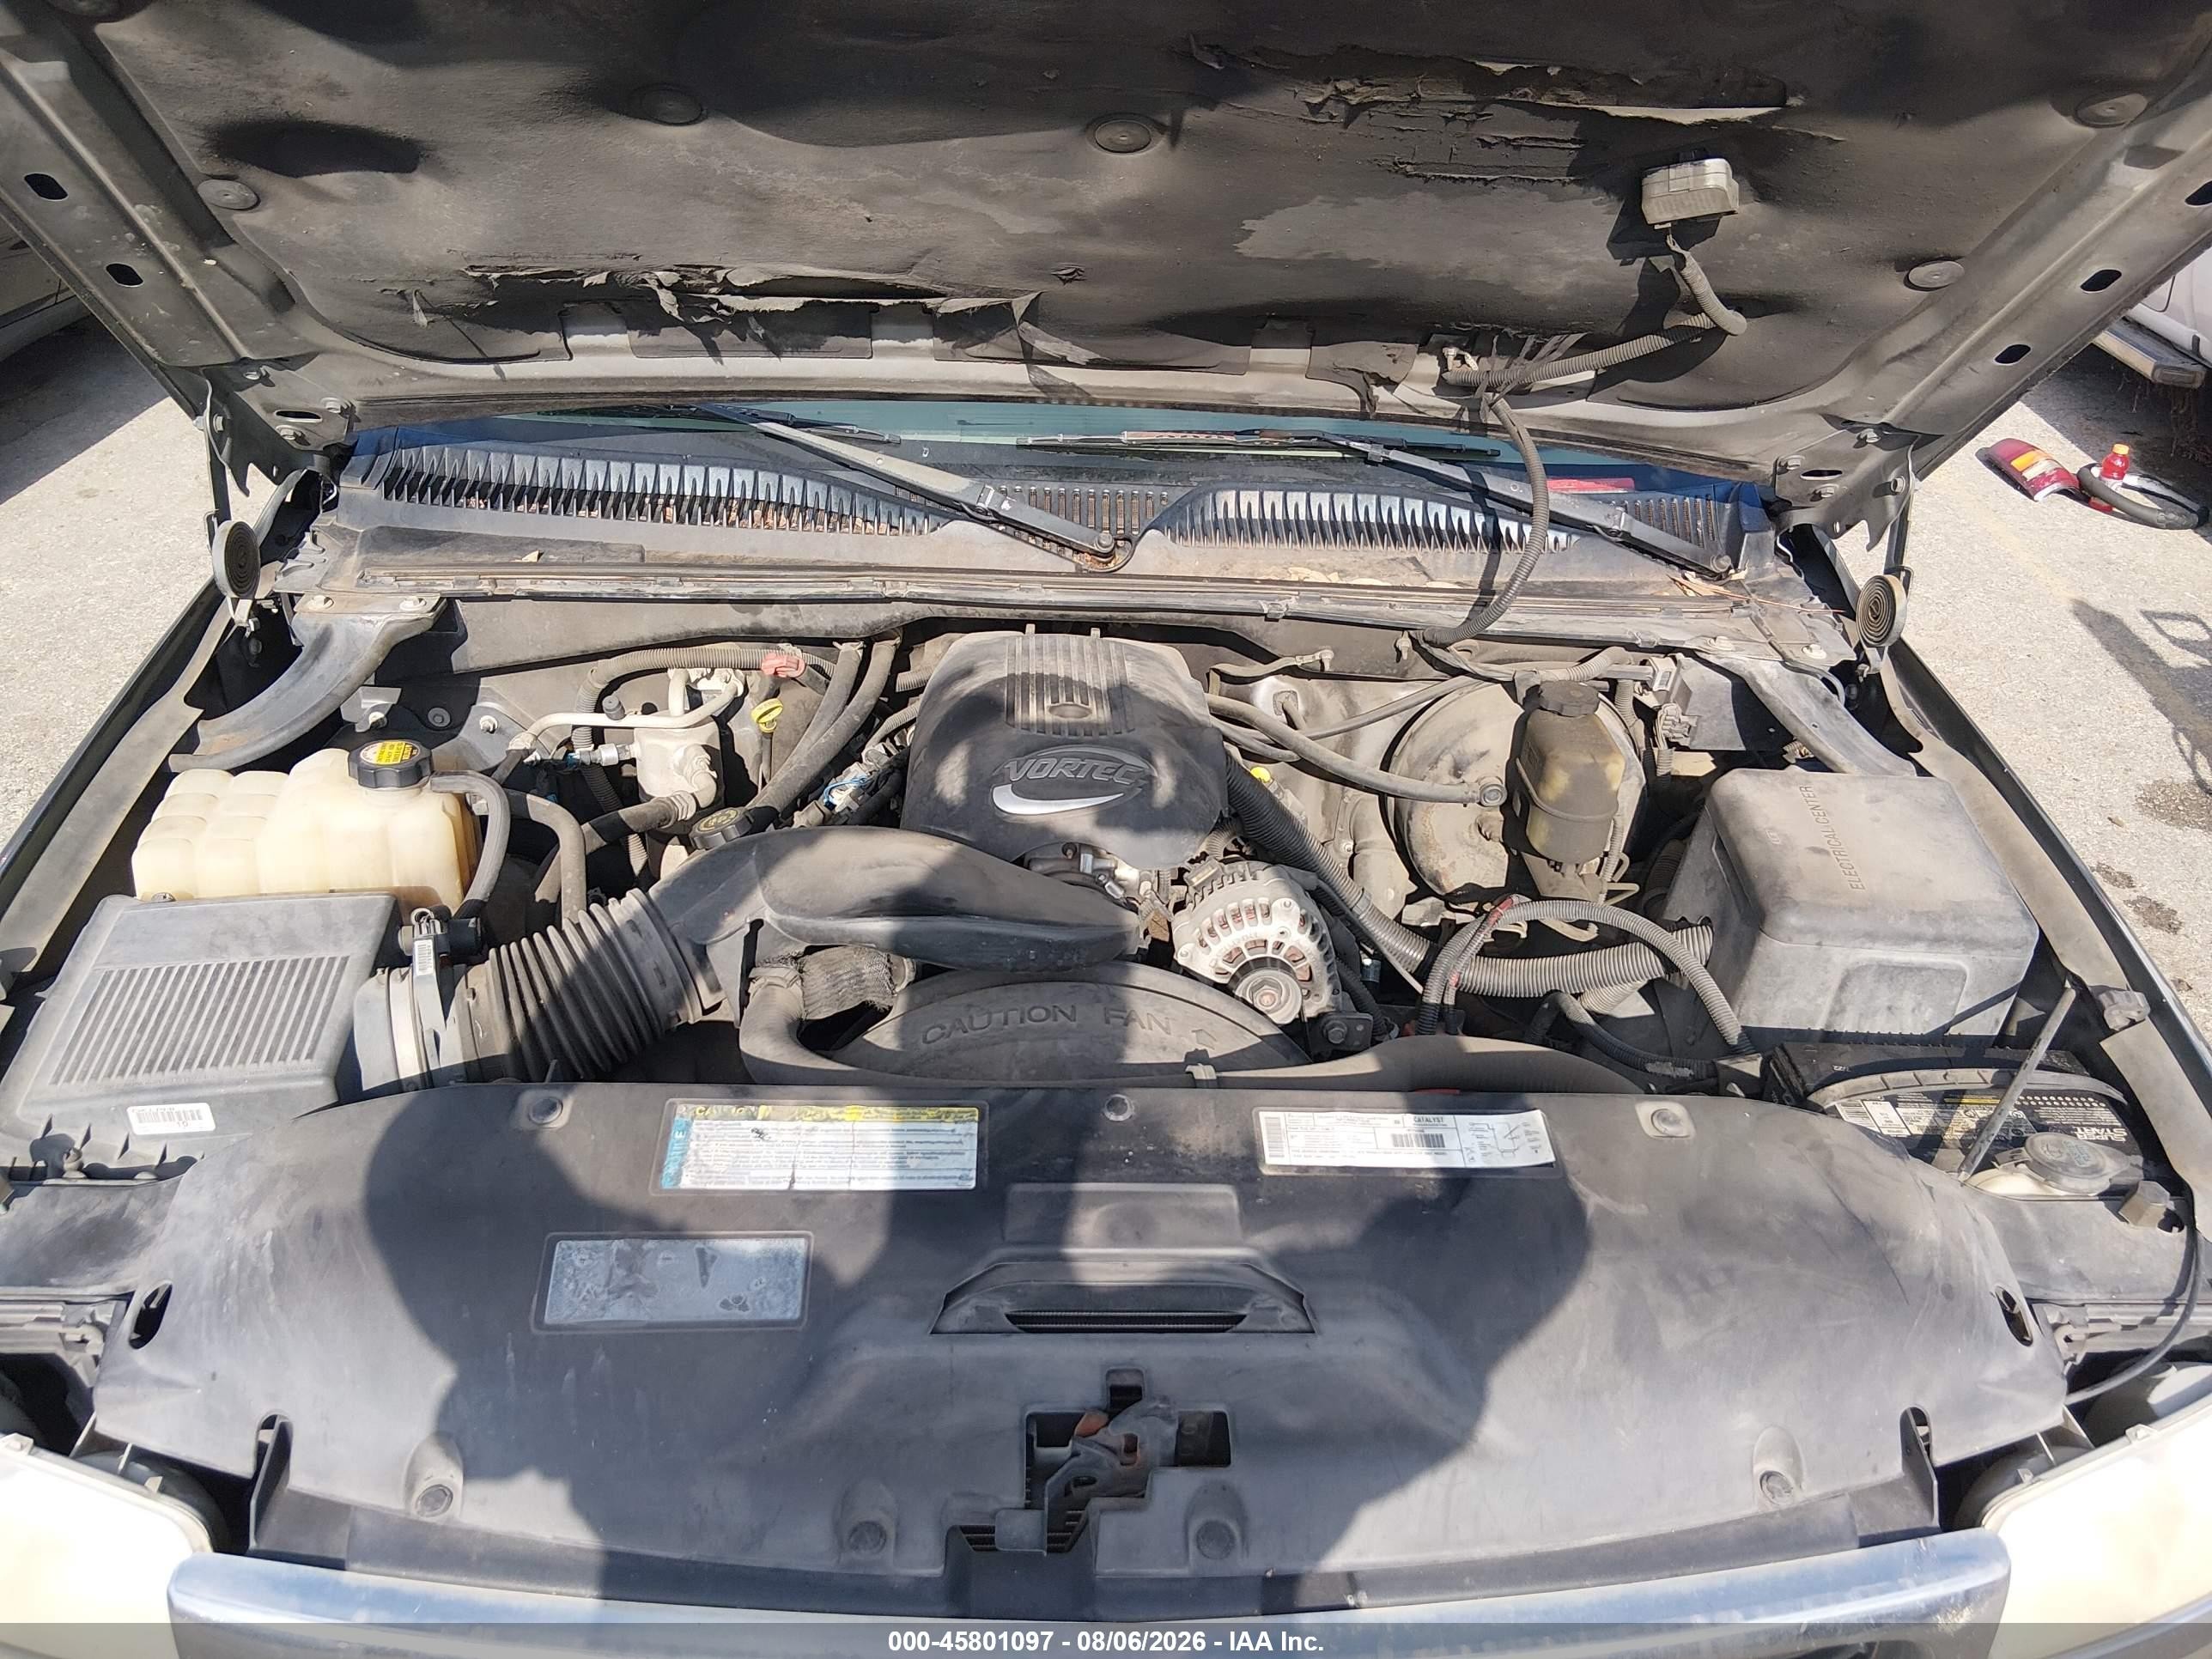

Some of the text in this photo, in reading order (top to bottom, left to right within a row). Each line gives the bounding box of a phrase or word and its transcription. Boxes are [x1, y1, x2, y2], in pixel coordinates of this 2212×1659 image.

[1004, 757, 1145, 785] VORTEC
[1799, 785, 1867, 891] ELECTRICAL CENTER
[921, 1003, 1174, 1045] CAUTION FAN
[2072, 1126, 2128, 1136] START
[2075, 1133, 2126, 1142] SUPER
